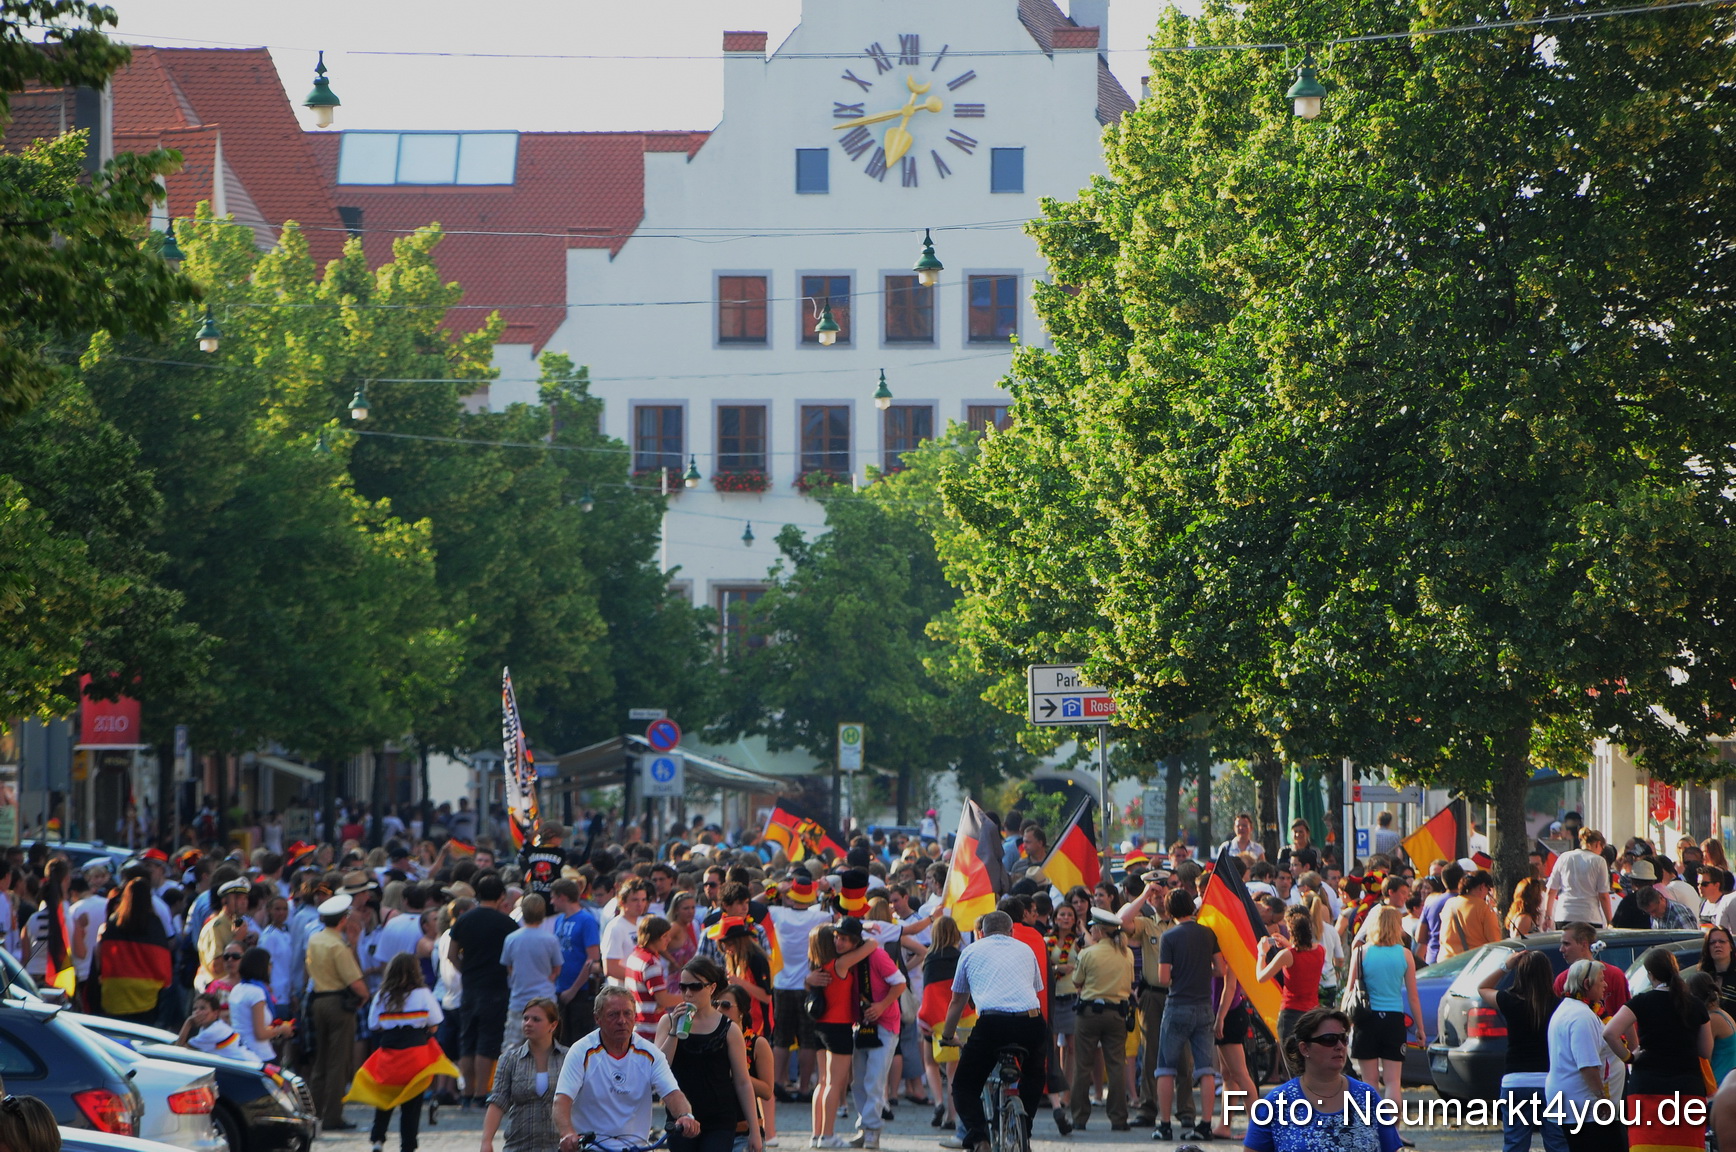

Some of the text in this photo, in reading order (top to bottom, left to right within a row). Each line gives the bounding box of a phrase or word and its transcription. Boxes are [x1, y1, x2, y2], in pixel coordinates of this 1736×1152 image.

[864, 42, 893, 75] XI
[898, 34, 919, 65] XII
[931, 44, 949, 72] I
[841, 69, 873, 93] X
[946, 70, 977, 91] II
[833, 102, 865, 118] IX
[954, 103, 985, 118] III
[931, 150, 952, 179] V
